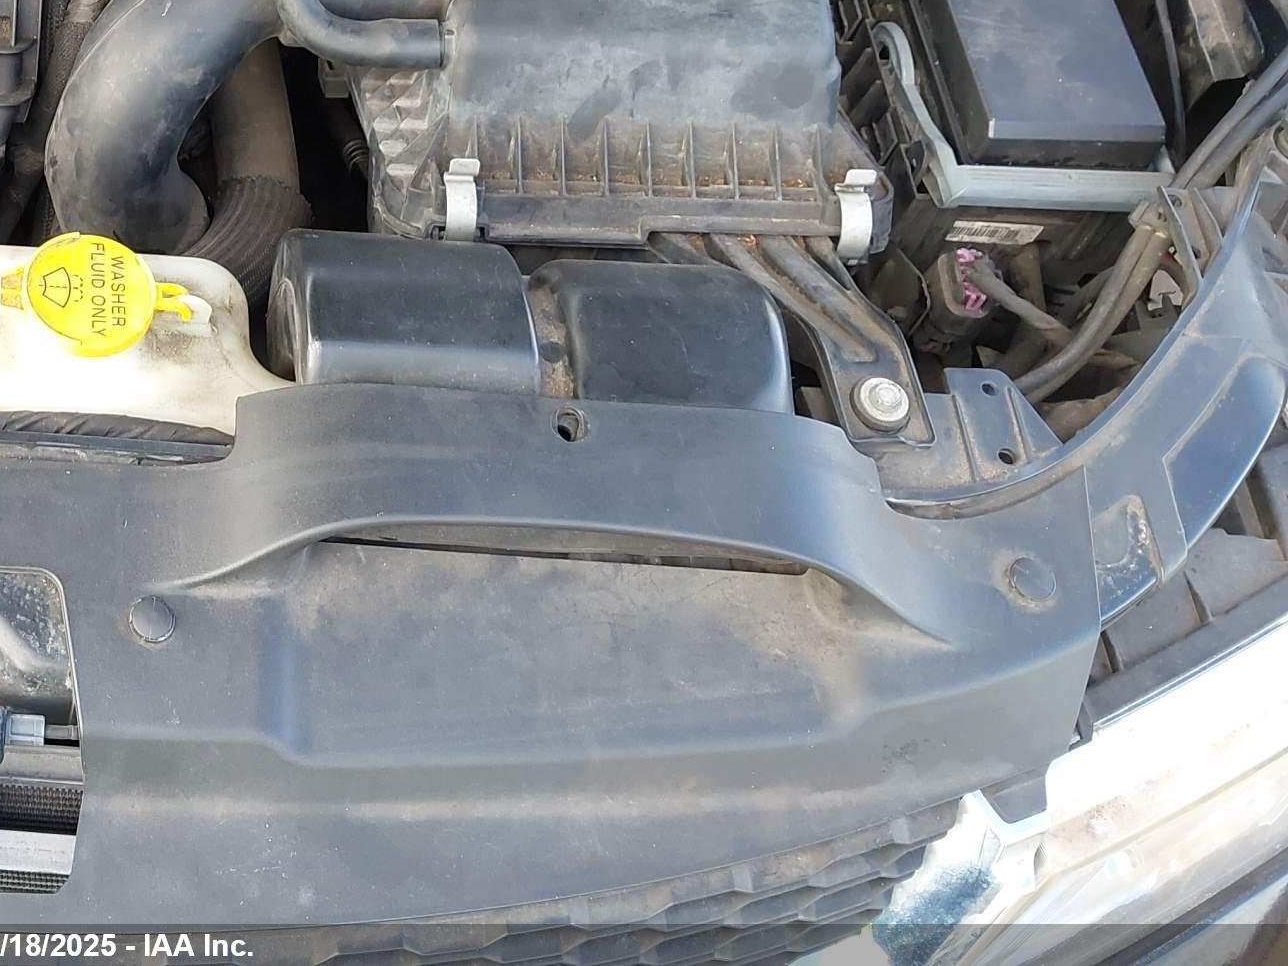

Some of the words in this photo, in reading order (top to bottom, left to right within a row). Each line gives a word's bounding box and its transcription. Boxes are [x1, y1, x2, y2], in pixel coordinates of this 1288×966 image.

[91, 243, 105, 289] FLUID
[111, 256, 126, 327] WASHER
[92, 295, 107, 338] ONLY
